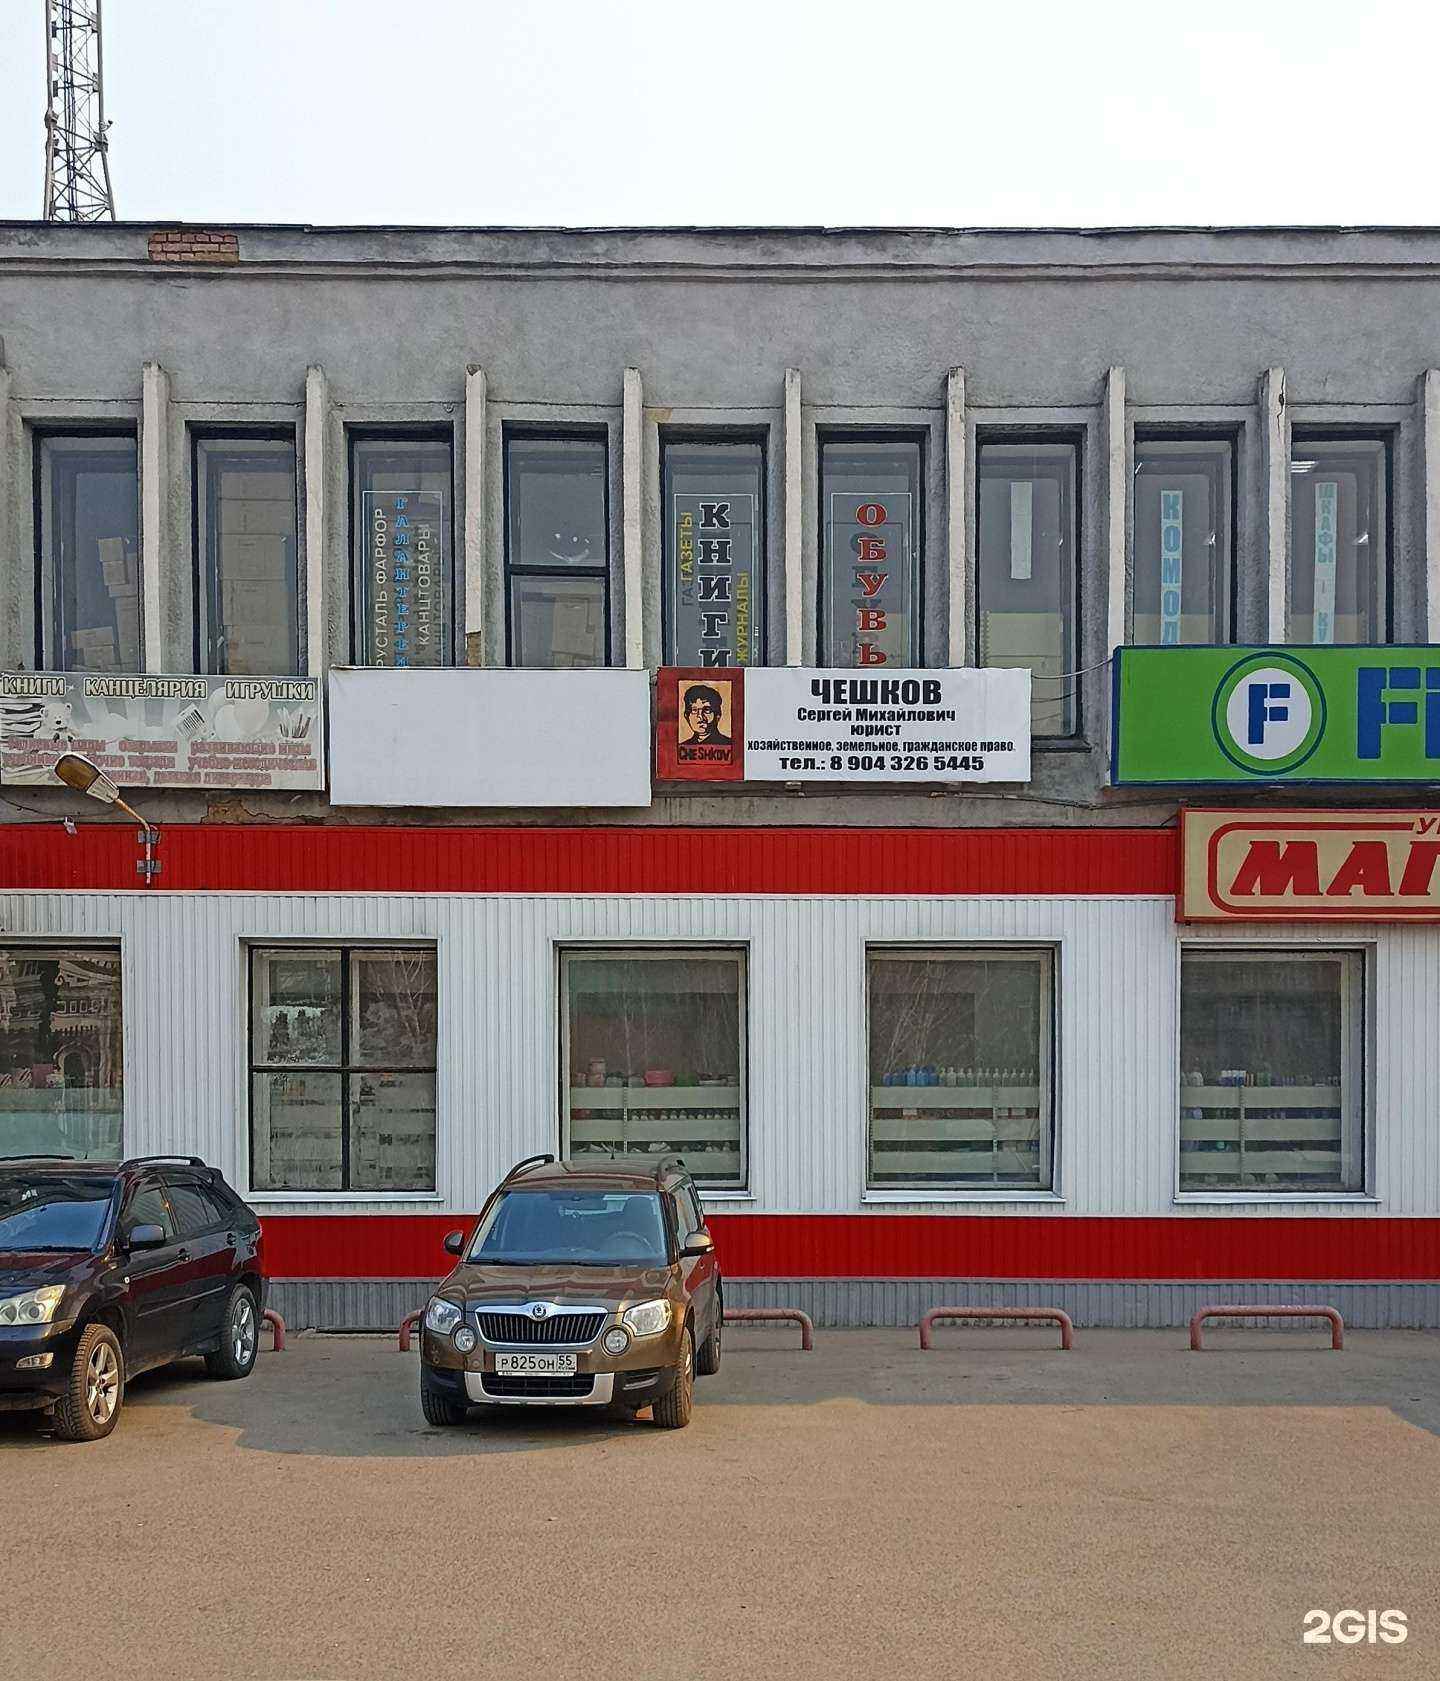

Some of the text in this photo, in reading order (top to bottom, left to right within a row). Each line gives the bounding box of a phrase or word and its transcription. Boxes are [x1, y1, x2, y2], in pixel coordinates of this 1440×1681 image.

[375, 508, 387, 584] ФАРФОР
[681, 511, 693, 582] ГАЗЕТЫ
[418, 524, 431, 646] КАНЦТОВАРЫ
[698, 503, 732, 666] КНИГИ
[736, 571, 749, 663] ЖУРНАЛЫ
[855, 503, 888, 665] ОБУВЬ
[3, 676, 314, 700] КНИГИ КАНЦЕЛЯРИЯ ИГРУШКИ
[797, 707, 956, 722] Сергей Михайлович
[811, 679, 942, 705] ЧЕШКОВ
[1248, 683, 1290, 745] F
[830, 756, 844, 771] 8
[847, 756, 887, 771] 904
[890, 756, 929, 771] 326
[933, 756, 984, 771] 5445
[903, 741, 979, 753] гражданское
